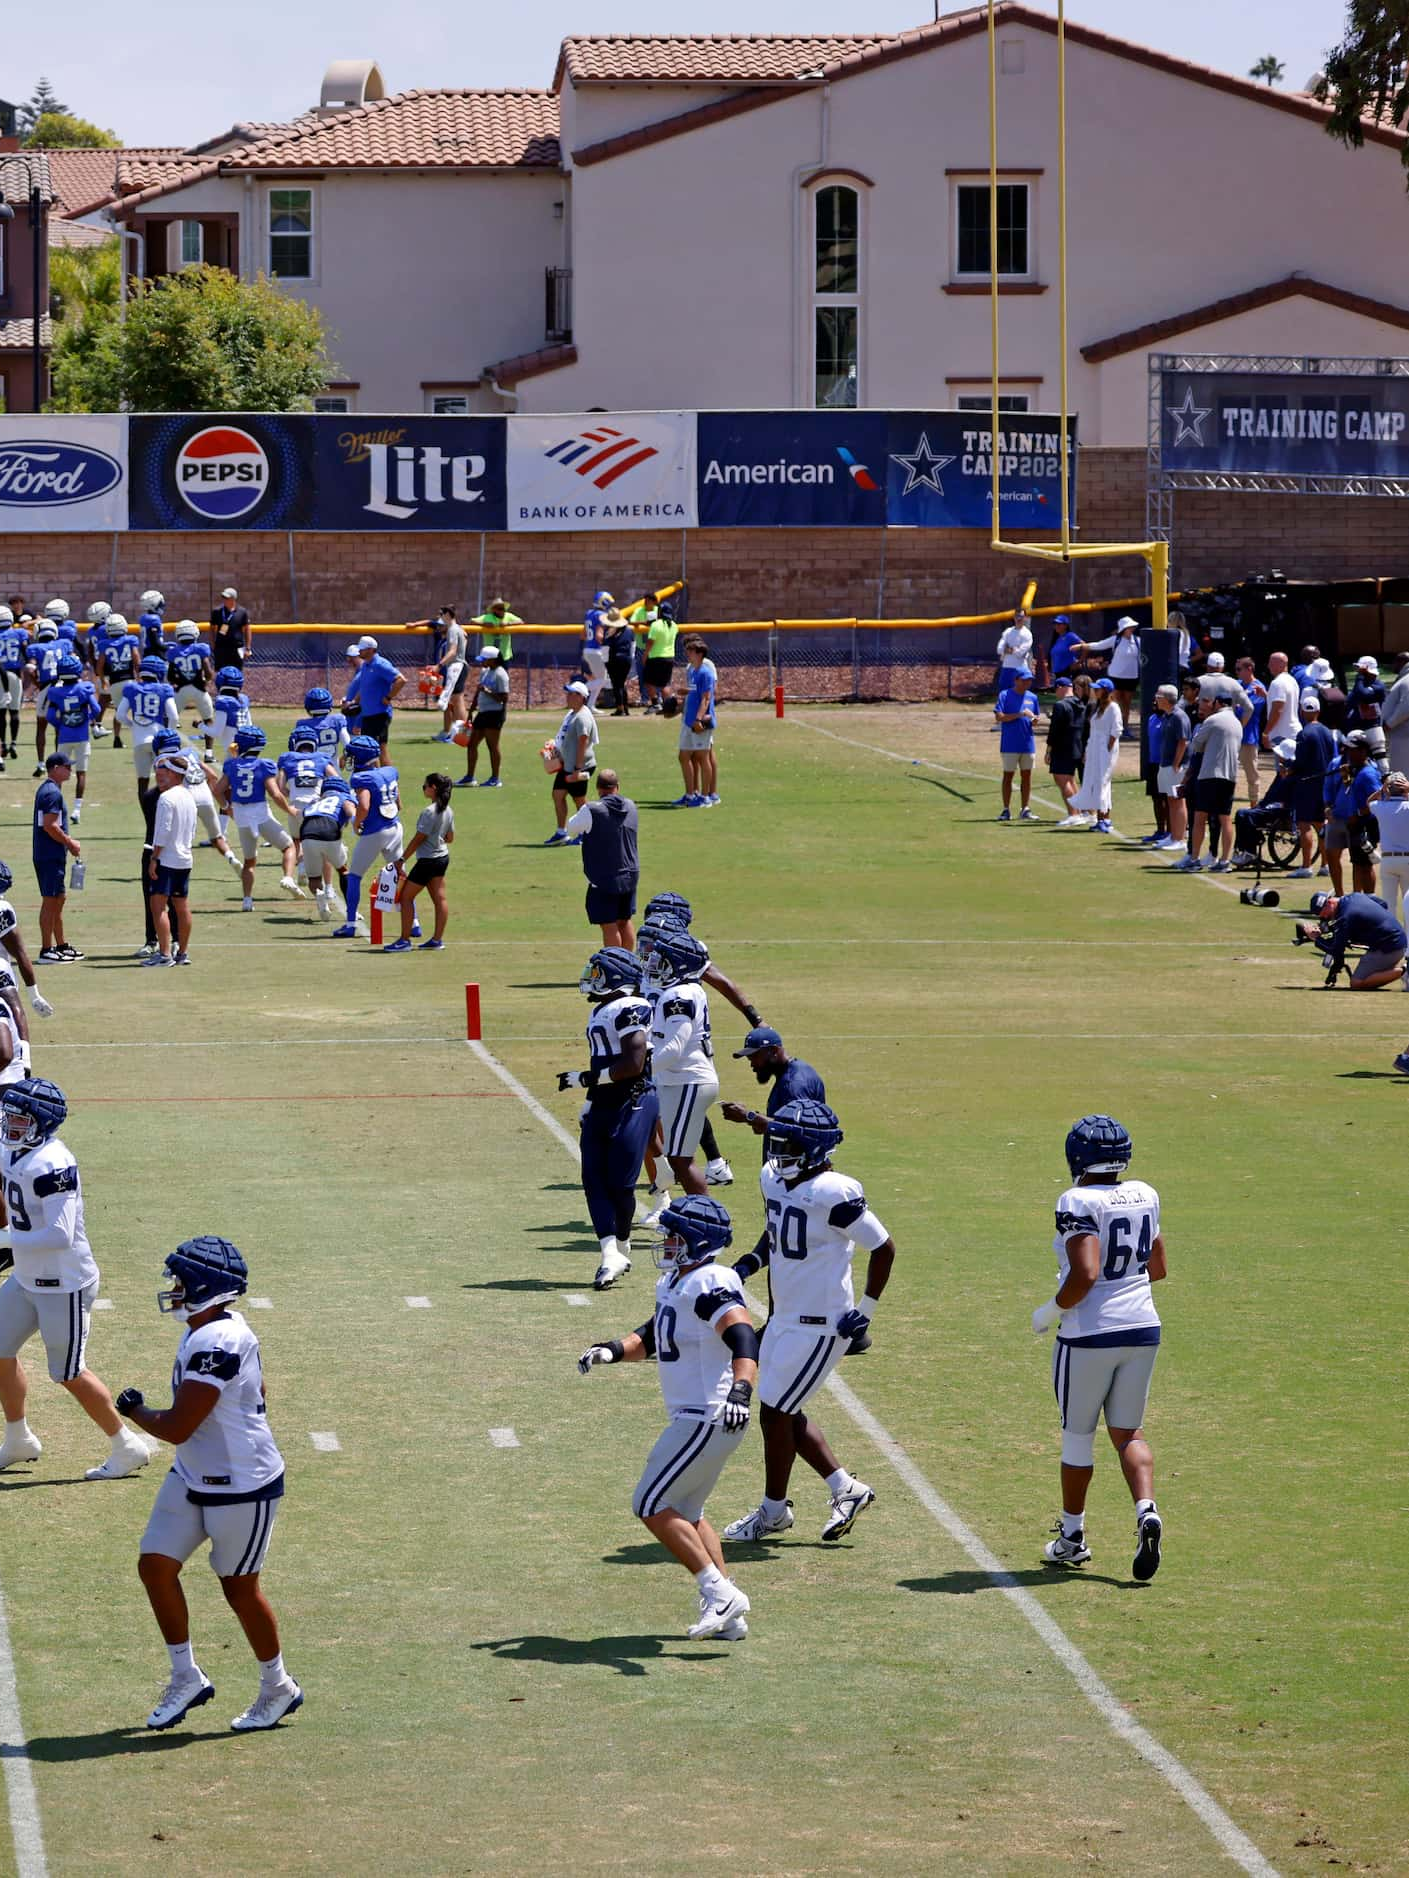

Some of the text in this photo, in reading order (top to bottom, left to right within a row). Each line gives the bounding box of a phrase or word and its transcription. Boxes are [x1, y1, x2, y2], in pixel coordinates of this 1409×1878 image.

[1223, 408, 1405, 441] TRAINING CAMP
[337, 428, 407, 464] Miller
[182, 463, 262, 482] PEPSI
[362, 443, 486, 519] Lite
[703, 459, 834, 485] American
[986, 490, 1032, 501] Aerican
[520, 503, 685, 519] BANK OF AMERICA
[105, 644, 132, 662] 34
[135, 692, 161, 717] 18
[236, 769, 254, 797] 3
[1103, 1213, 1152, 1281] 64
